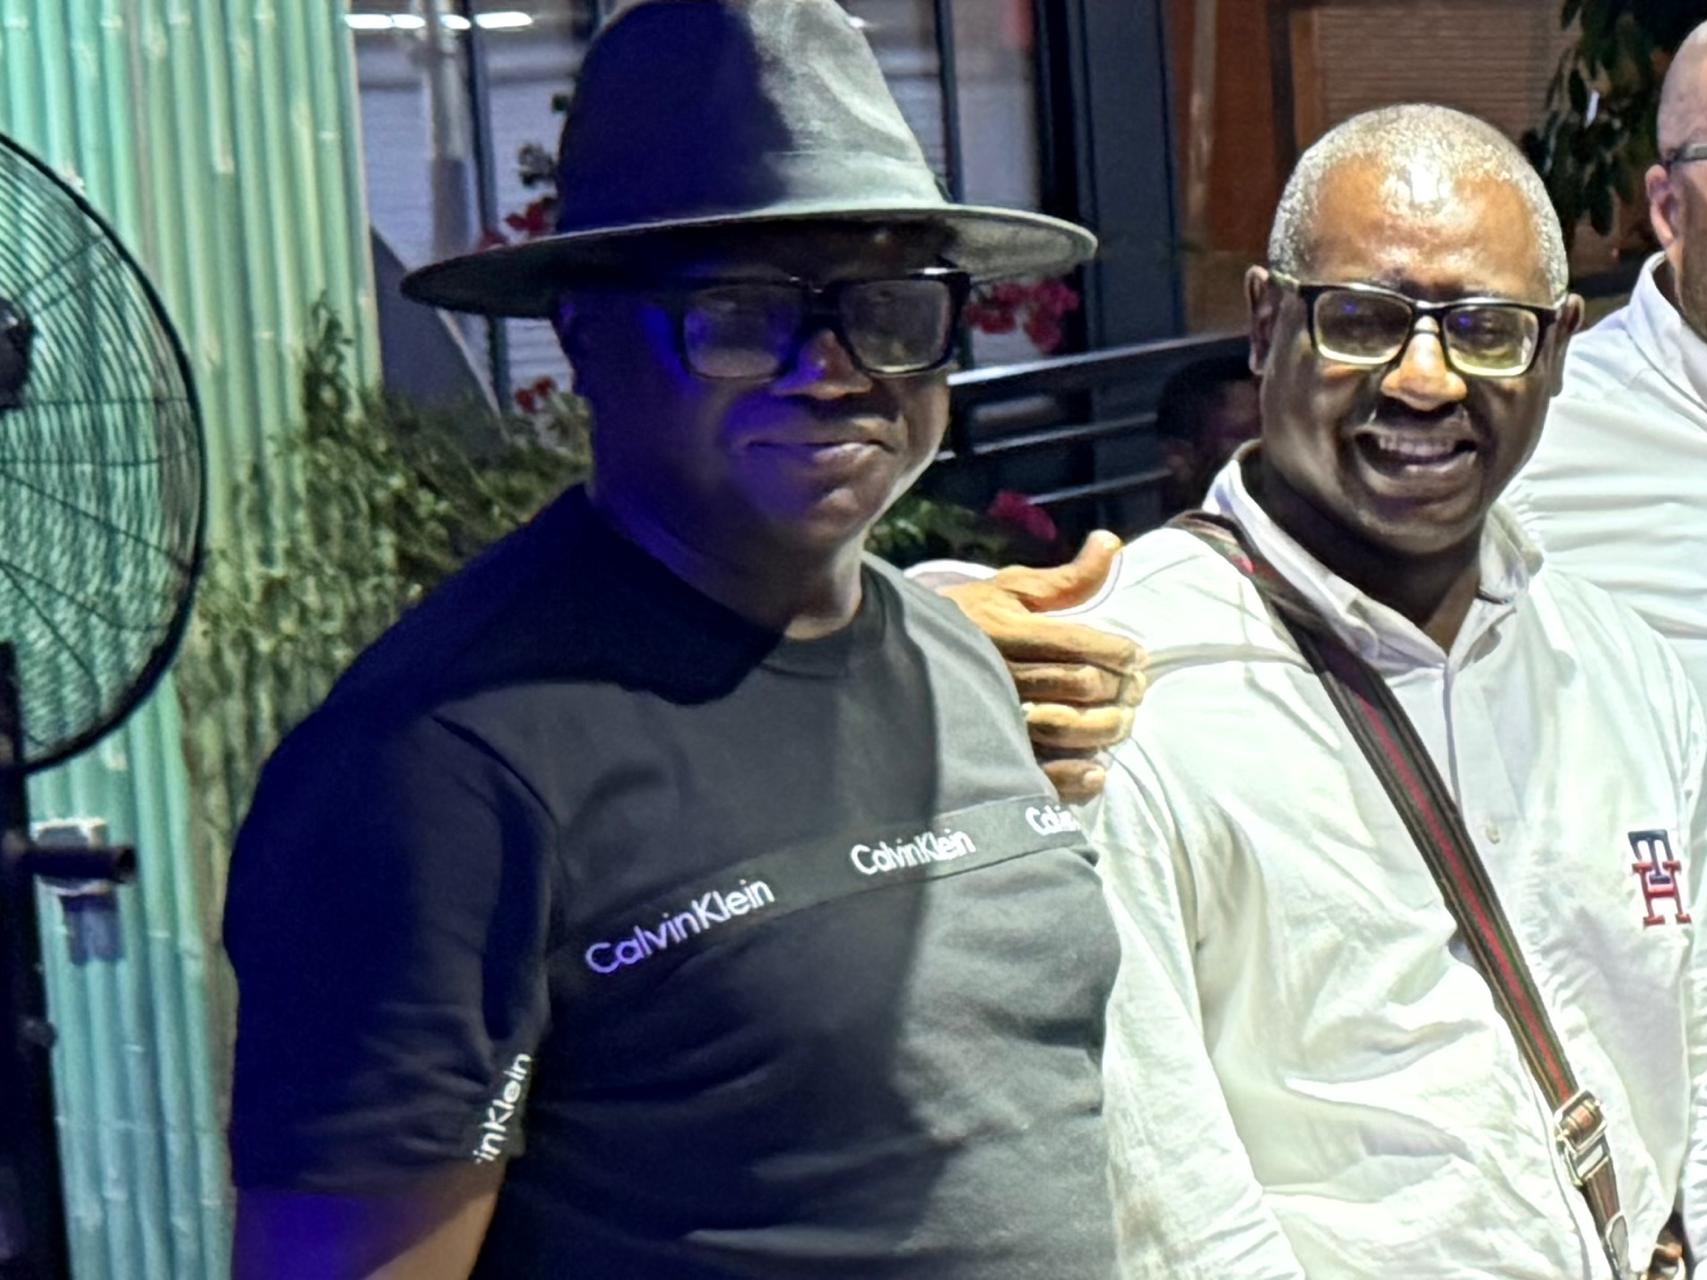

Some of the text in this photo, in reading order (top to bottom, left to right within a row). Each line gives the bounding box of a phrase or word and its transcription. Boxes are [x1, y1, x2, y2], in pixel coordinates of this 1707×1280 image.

[585, 877, 775, 974] CalvinKlein
[850, 828, 976, 876] CalvinKlein
[472, 1053, 532, 1165] inKlein
